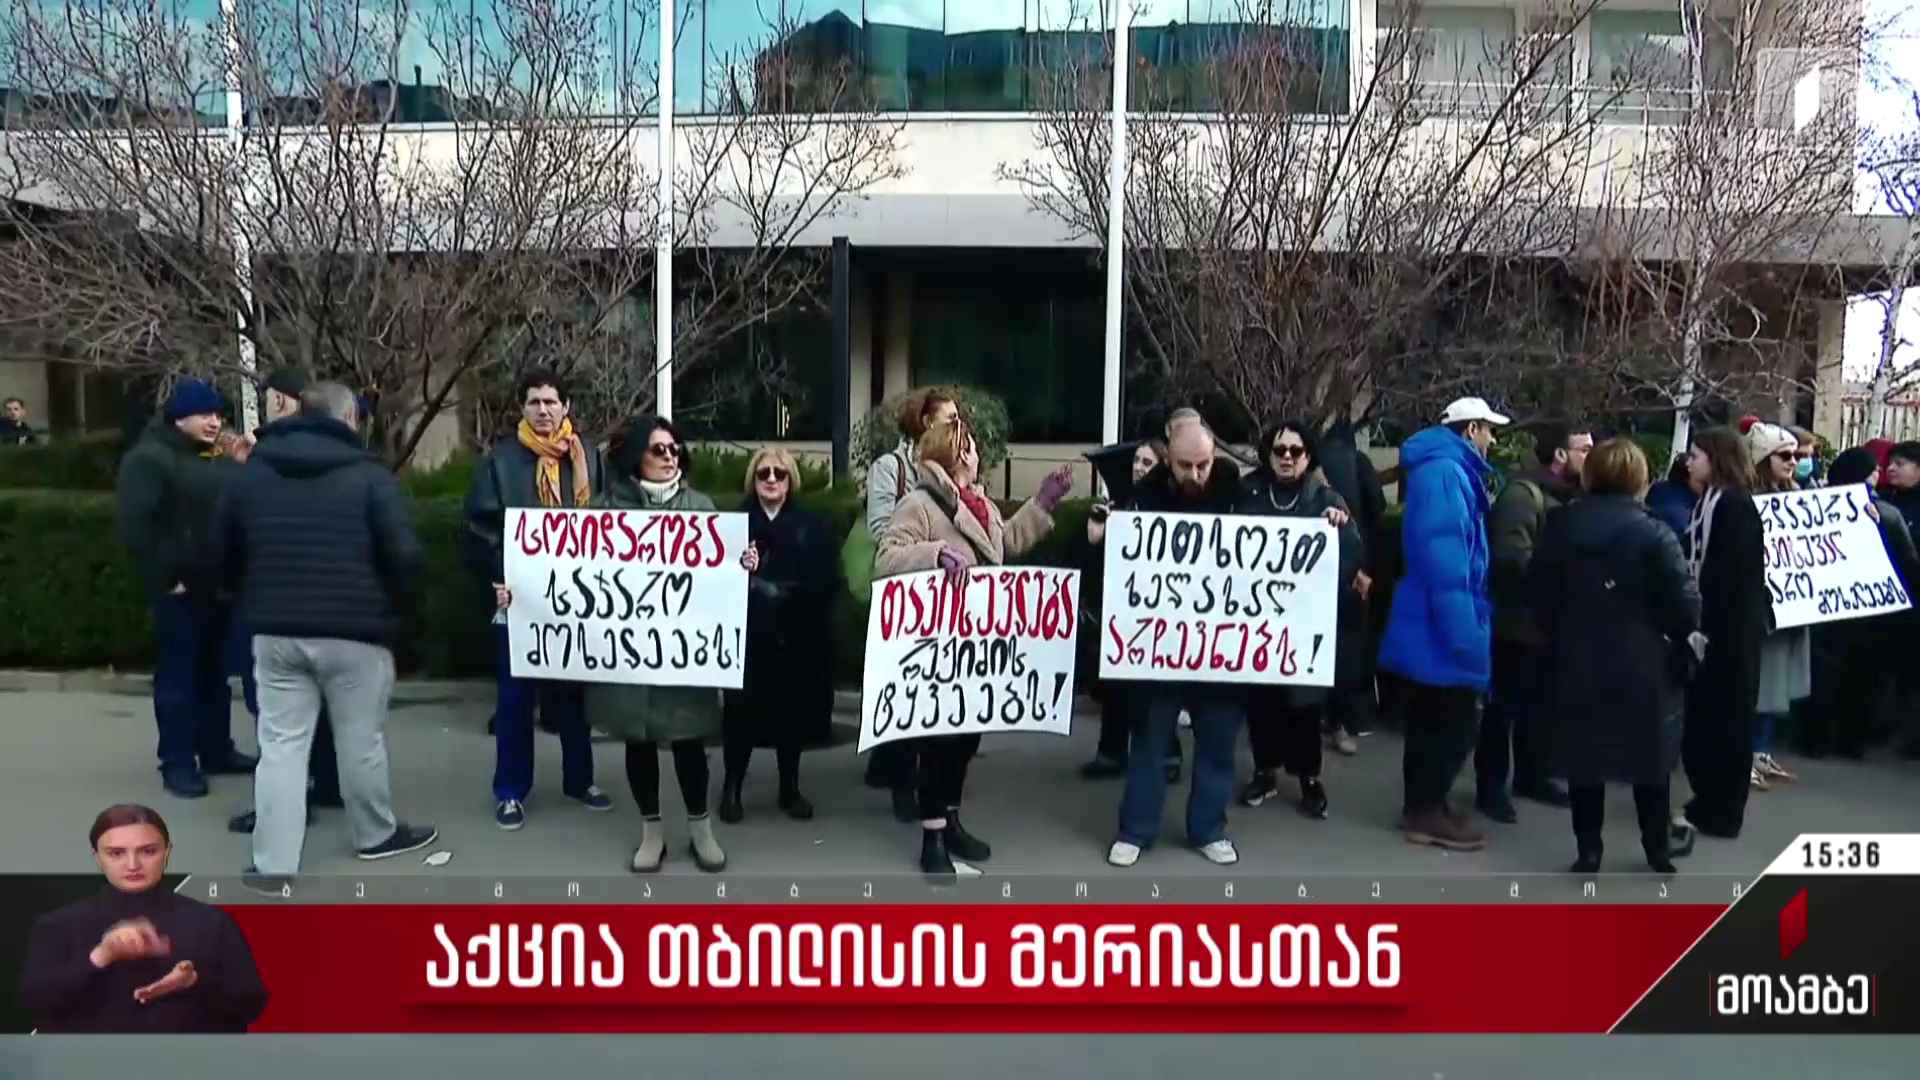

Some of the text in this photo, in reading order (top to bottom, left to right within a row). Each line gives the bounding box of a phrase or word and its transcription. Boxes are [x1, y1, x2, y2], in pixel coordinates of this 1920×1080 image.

[1759, 492, 1858, 532] რდაჭერა
[515, 511, 725, 568] სოლიდარობა
[1122, 516, 1327, 574] ვითხოვთ
[545, 566, 692, 620] საჯარო
[1125, 571, 1296, 616] ხელახალ
[1767, 571, 1814, 604] არო
